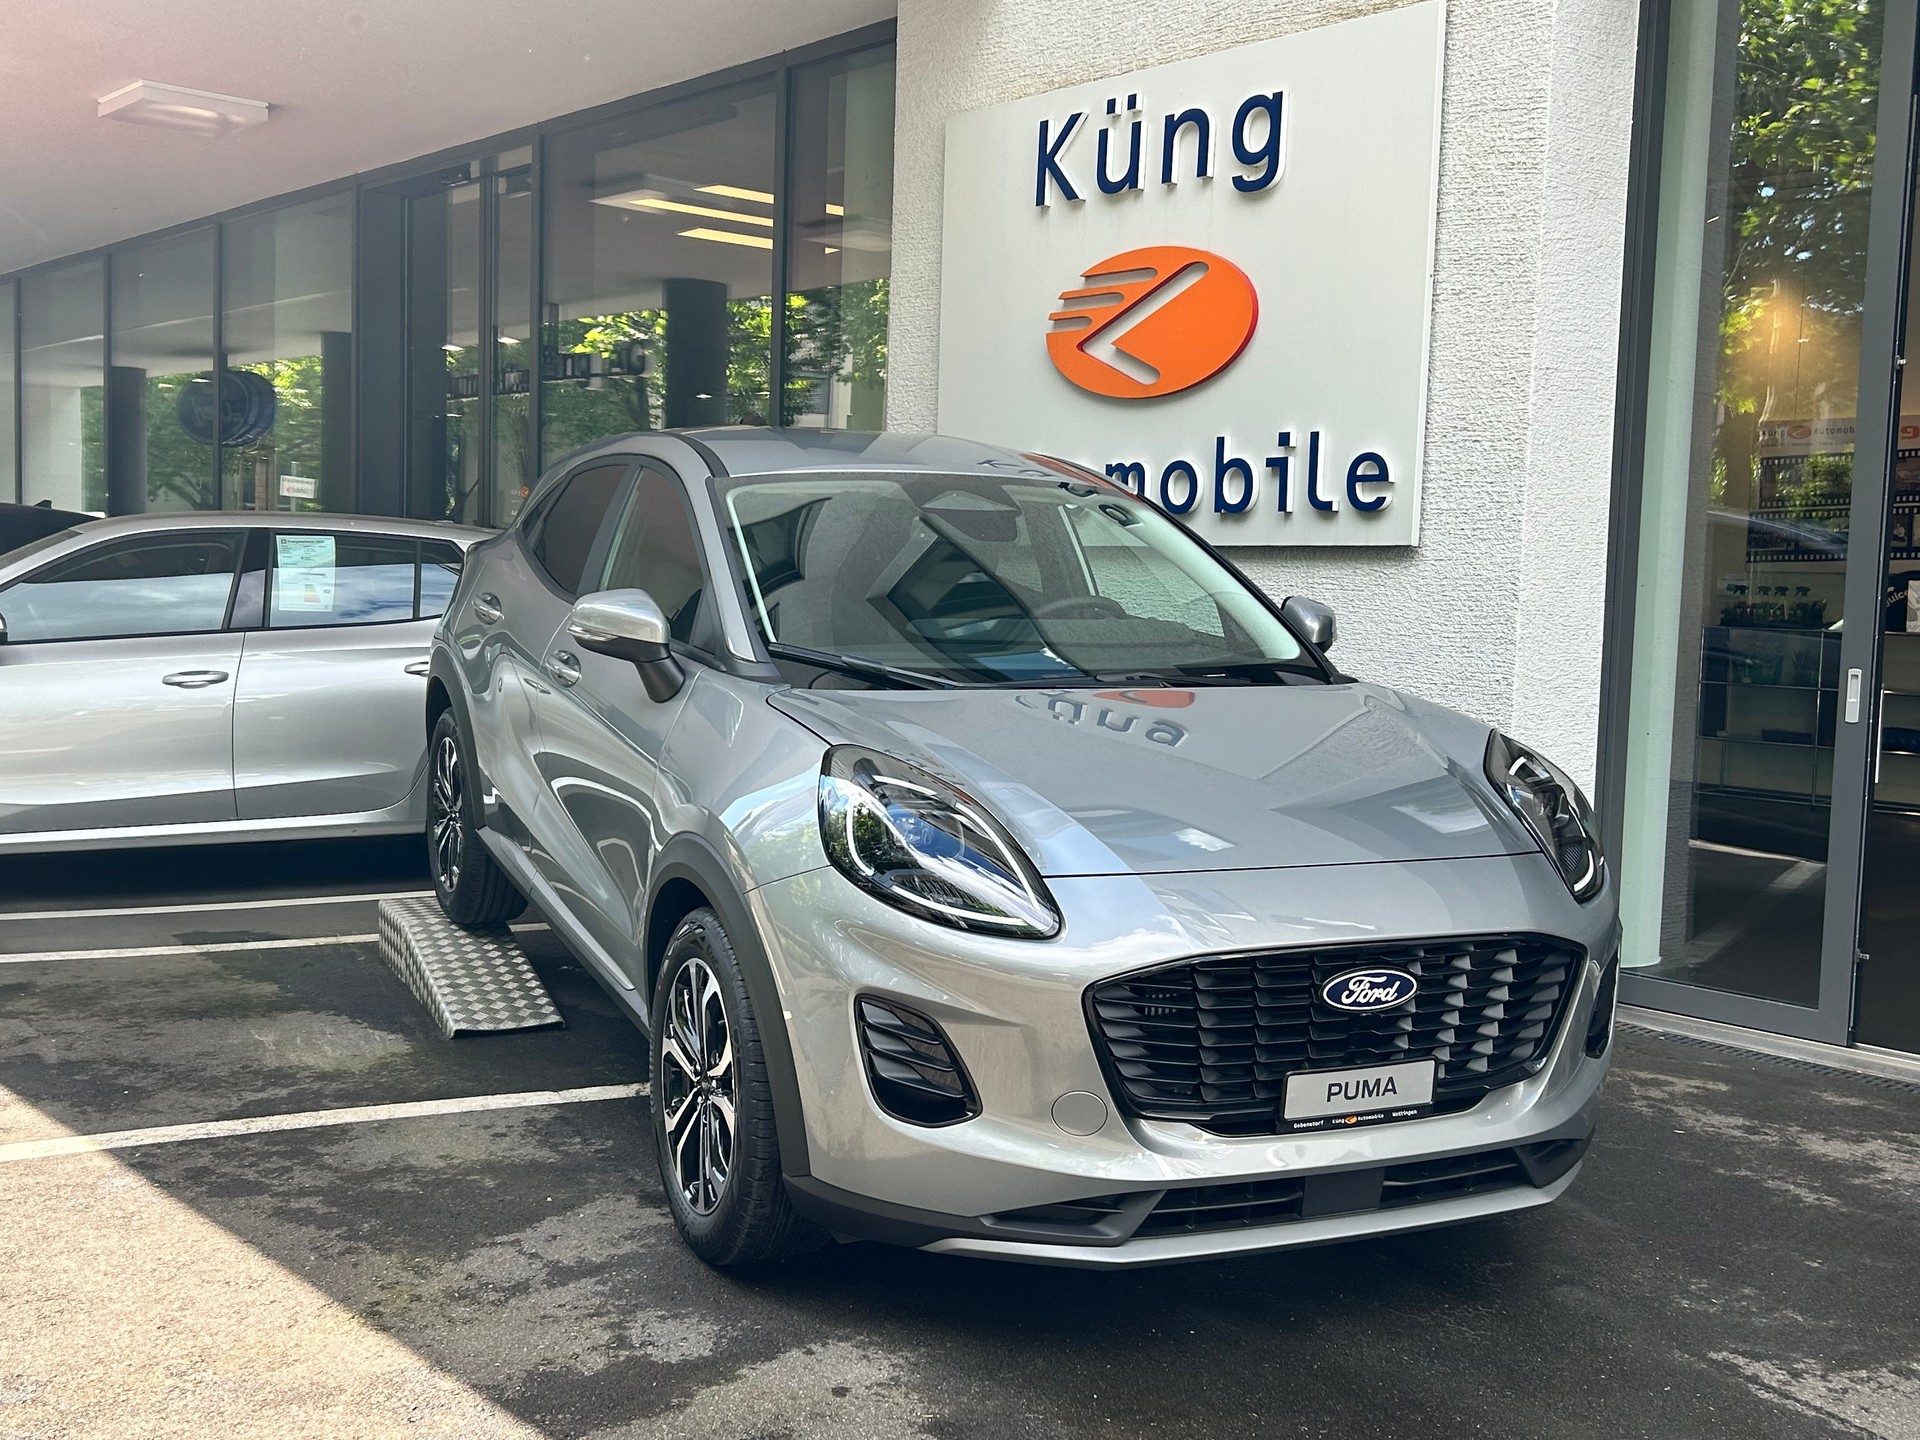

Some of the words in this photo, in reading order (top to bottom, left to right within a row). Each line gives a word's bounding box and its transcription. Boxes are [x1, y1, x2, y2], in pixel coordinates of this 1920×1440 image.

[1035, 90, 1288, 208] Küng
[1813, 426, 1855, 435] Automob
[1105, 430, 1395, 515] mobile
[1341, 975, 1401, 1005] Ford
[1326, 1076, 1398, 1103] PUMA
